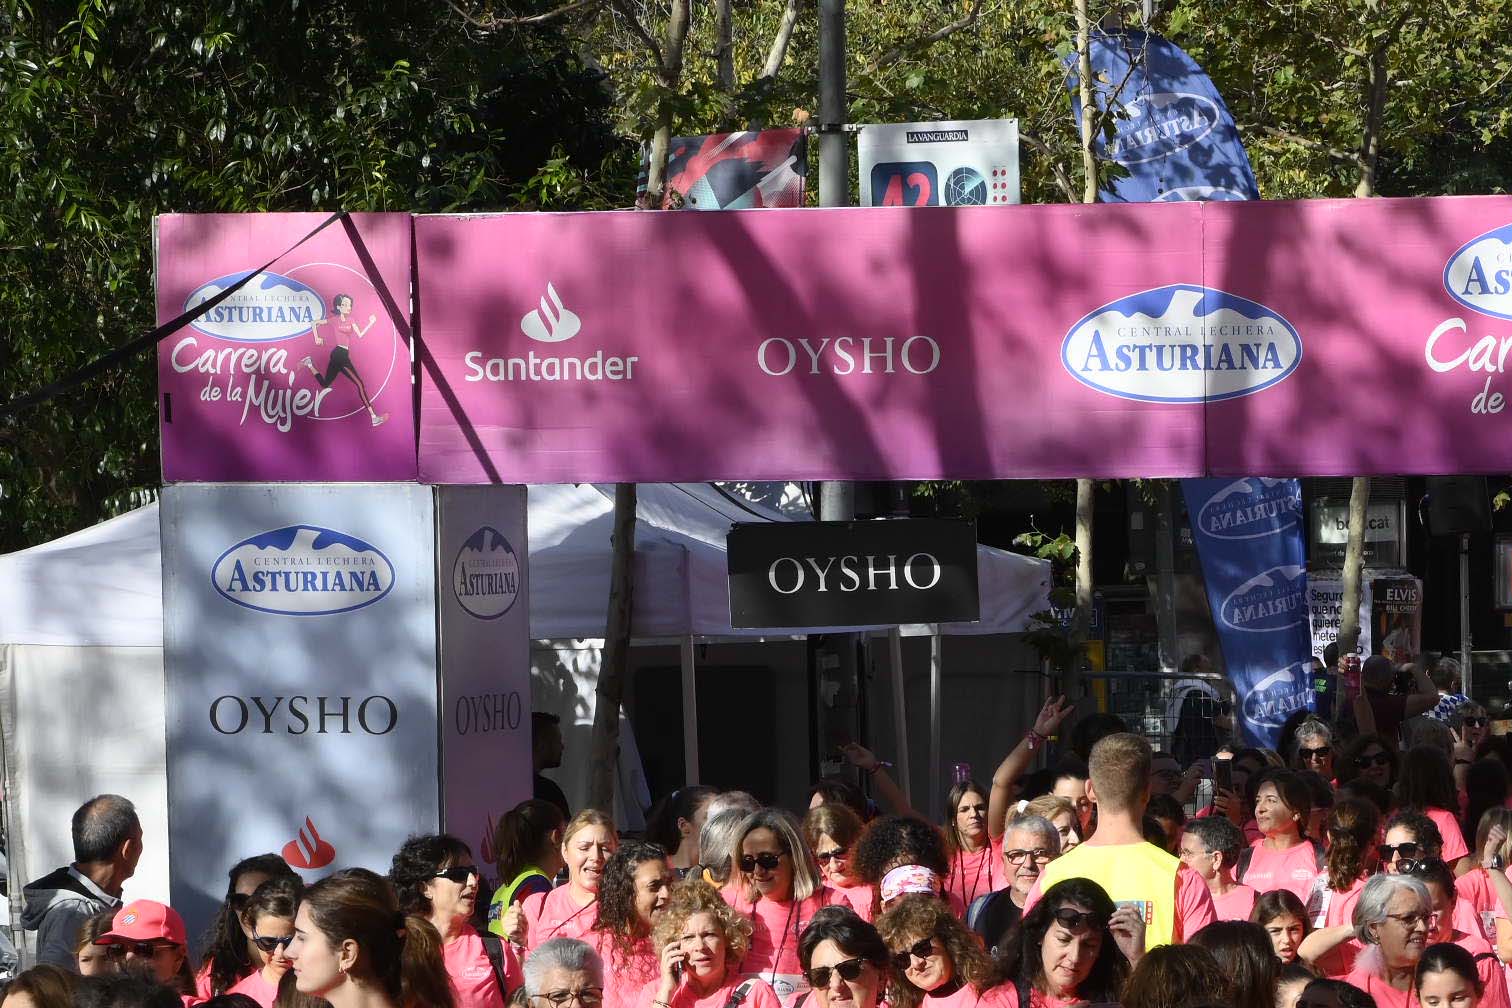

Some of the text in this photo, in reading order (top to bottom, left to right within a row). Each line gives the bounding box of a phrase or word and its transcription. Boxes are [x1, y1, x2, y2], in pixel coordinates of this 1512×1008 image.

[1117, 324, 1275, 338] CENTRAL LECHERA
[171, 336, 288, 375] Carrera
[464, 350, 639, 383] Santander
[757, 335, 941, 377] OYSHO
[1080, 329, 1284, 373] ASTURIANA
[200, 371, 332, 433] de la Mujer
[1470, 375, 1506, 415] de
[226, 558, 382, 593] ASTURIANA
[253, 556, 376, 567] CENTRAL LECHERA
[458, 561, 516, 597] ASTURIANA
[768, 552, 942, 594] OYSHO
[1386, 588, 1417, 601] ELVIS
[209, 694, 399, 735] OYSHO
[454, 691, 522, 737] OYSHO
